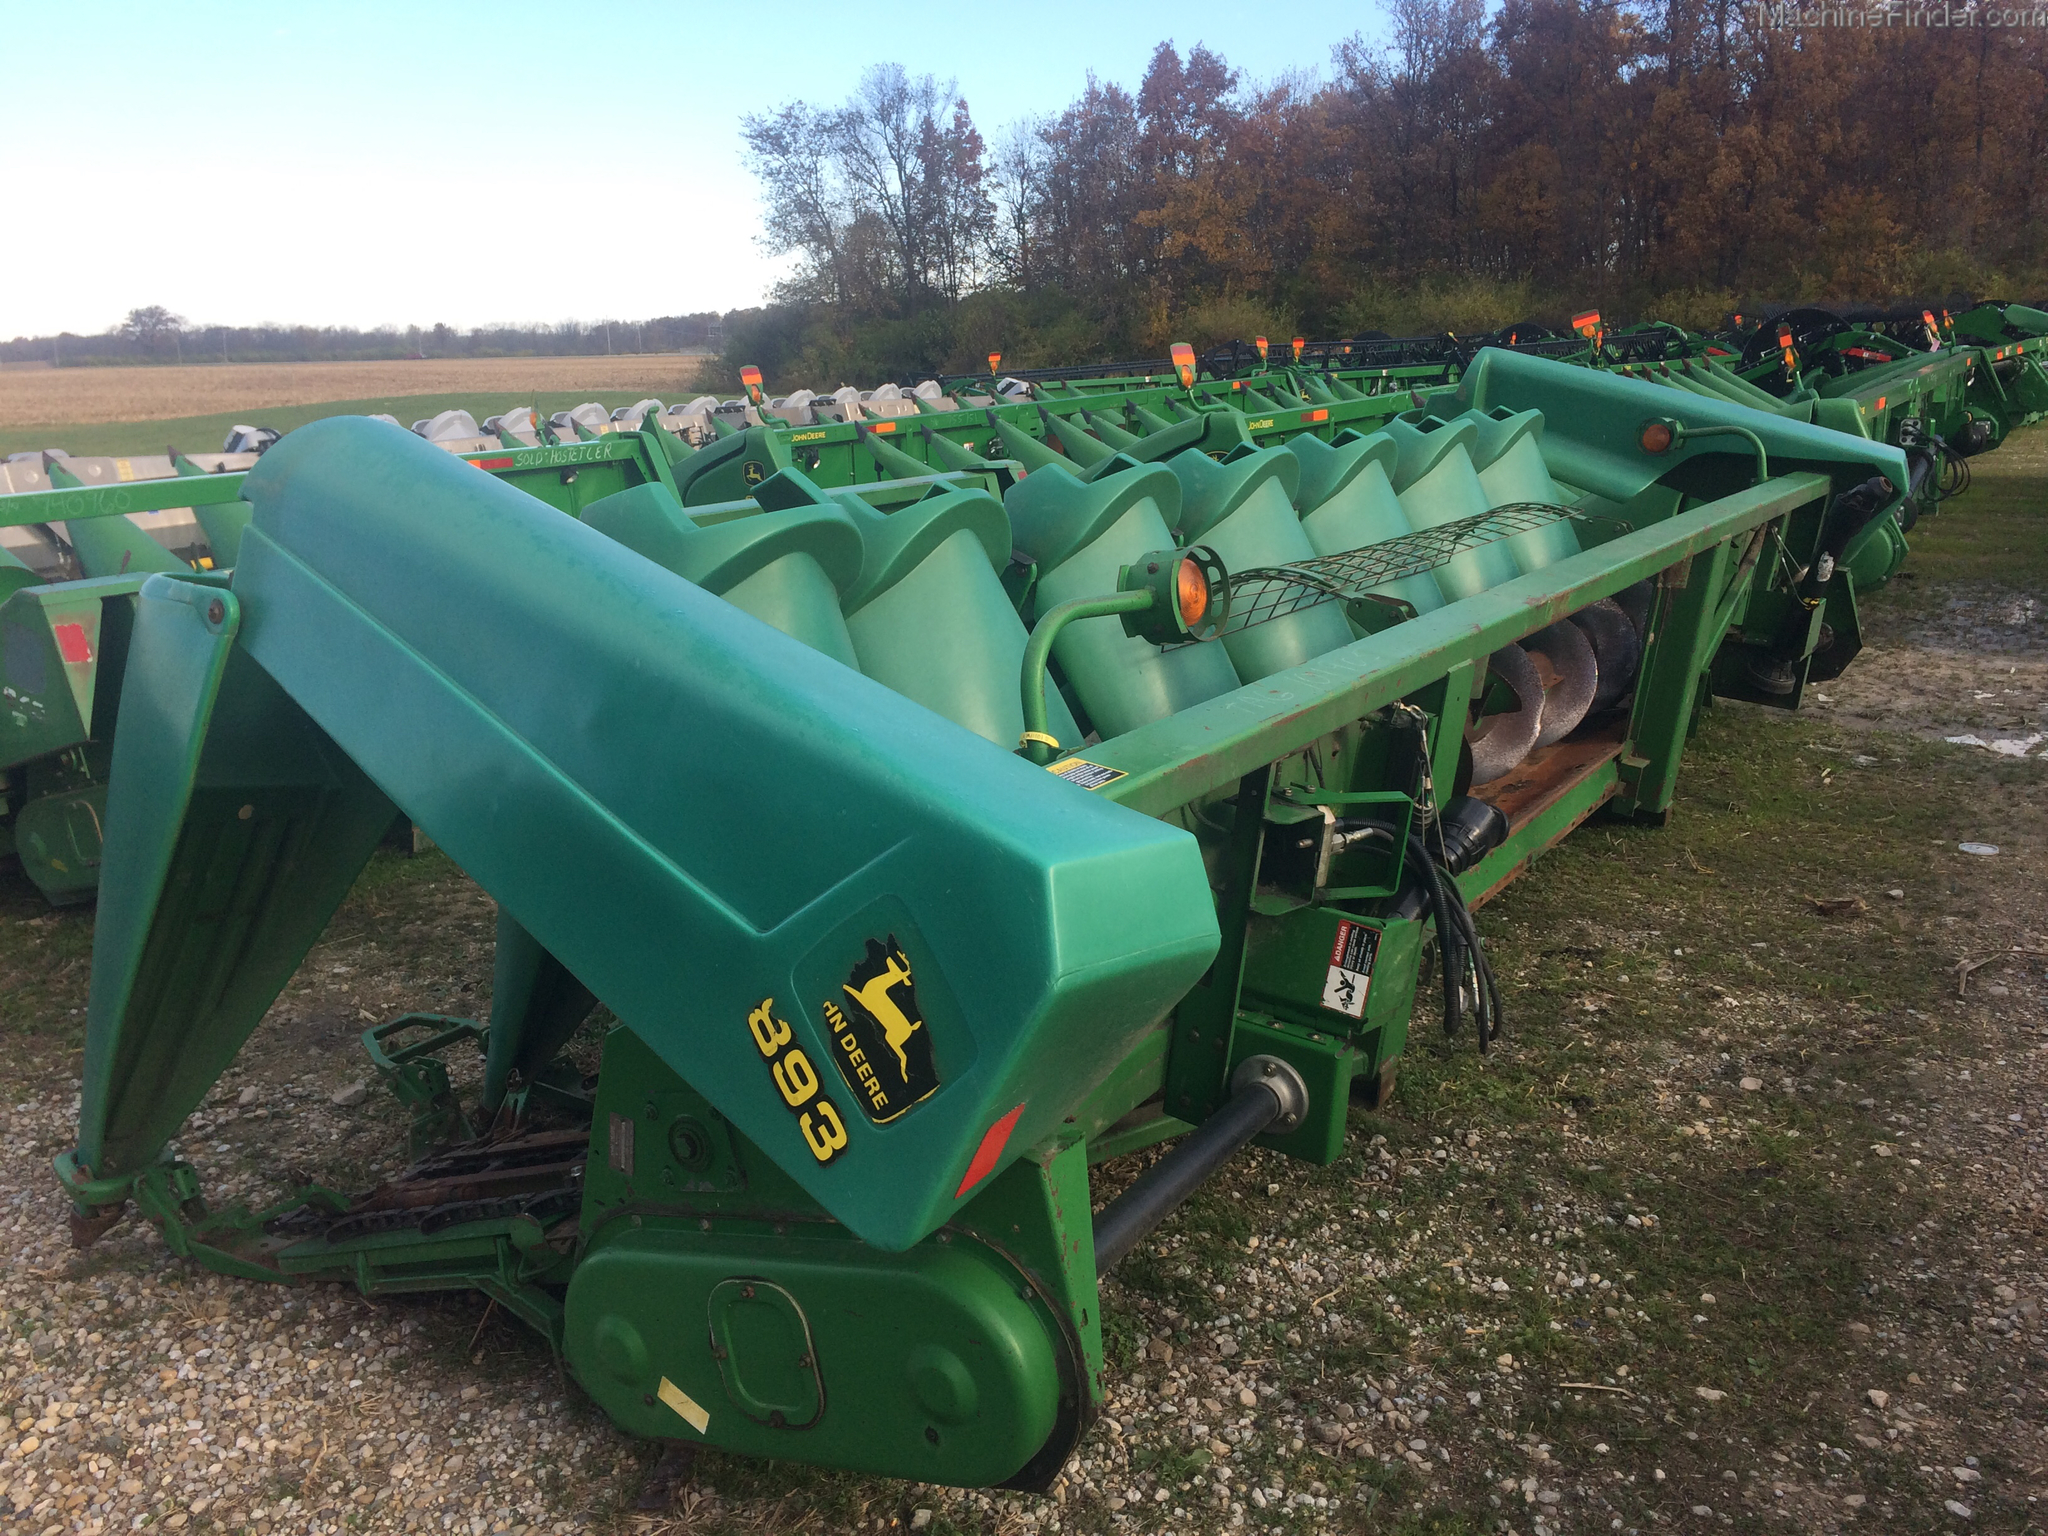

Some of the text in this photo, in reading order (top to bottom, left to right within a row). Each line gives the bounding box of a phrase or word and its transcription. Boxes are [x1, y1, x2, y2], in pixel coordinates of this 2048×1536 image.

[791, 431, 826, 442] JOHN DEERE
[1335, 925, 1348, 957] DANGER
[748, 998, 848, 1161] 893
[823, 1000, 889, 1111] HN DEERE
